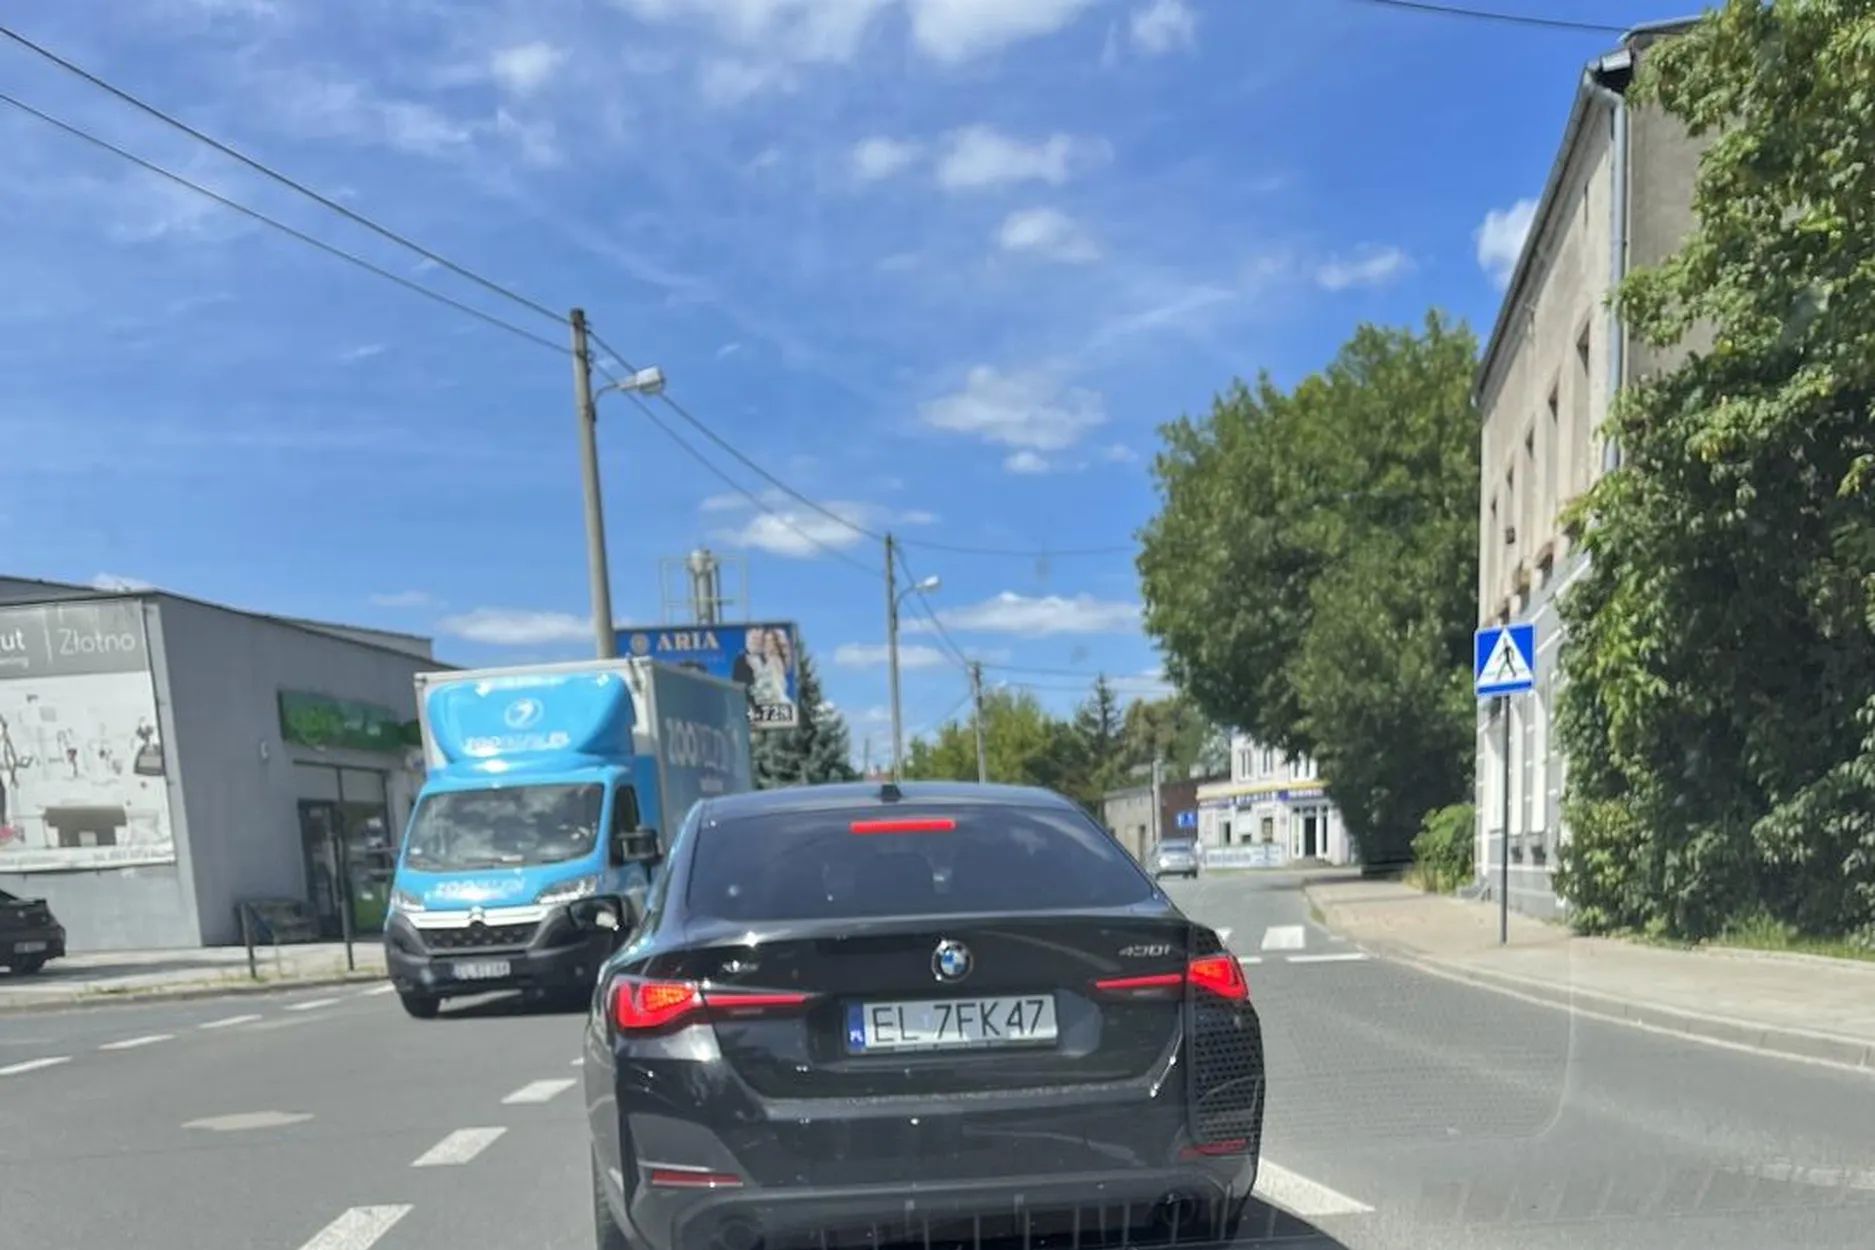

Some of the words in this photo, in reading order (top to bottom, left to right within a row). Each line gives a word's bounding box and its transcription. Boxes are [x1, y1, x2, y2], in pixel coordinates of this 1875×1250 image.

[657, 630, 720, 652] ARIA
[872, 1005, 918, 1042] EL
[934, 999, 1046, 1040] 7FK47
